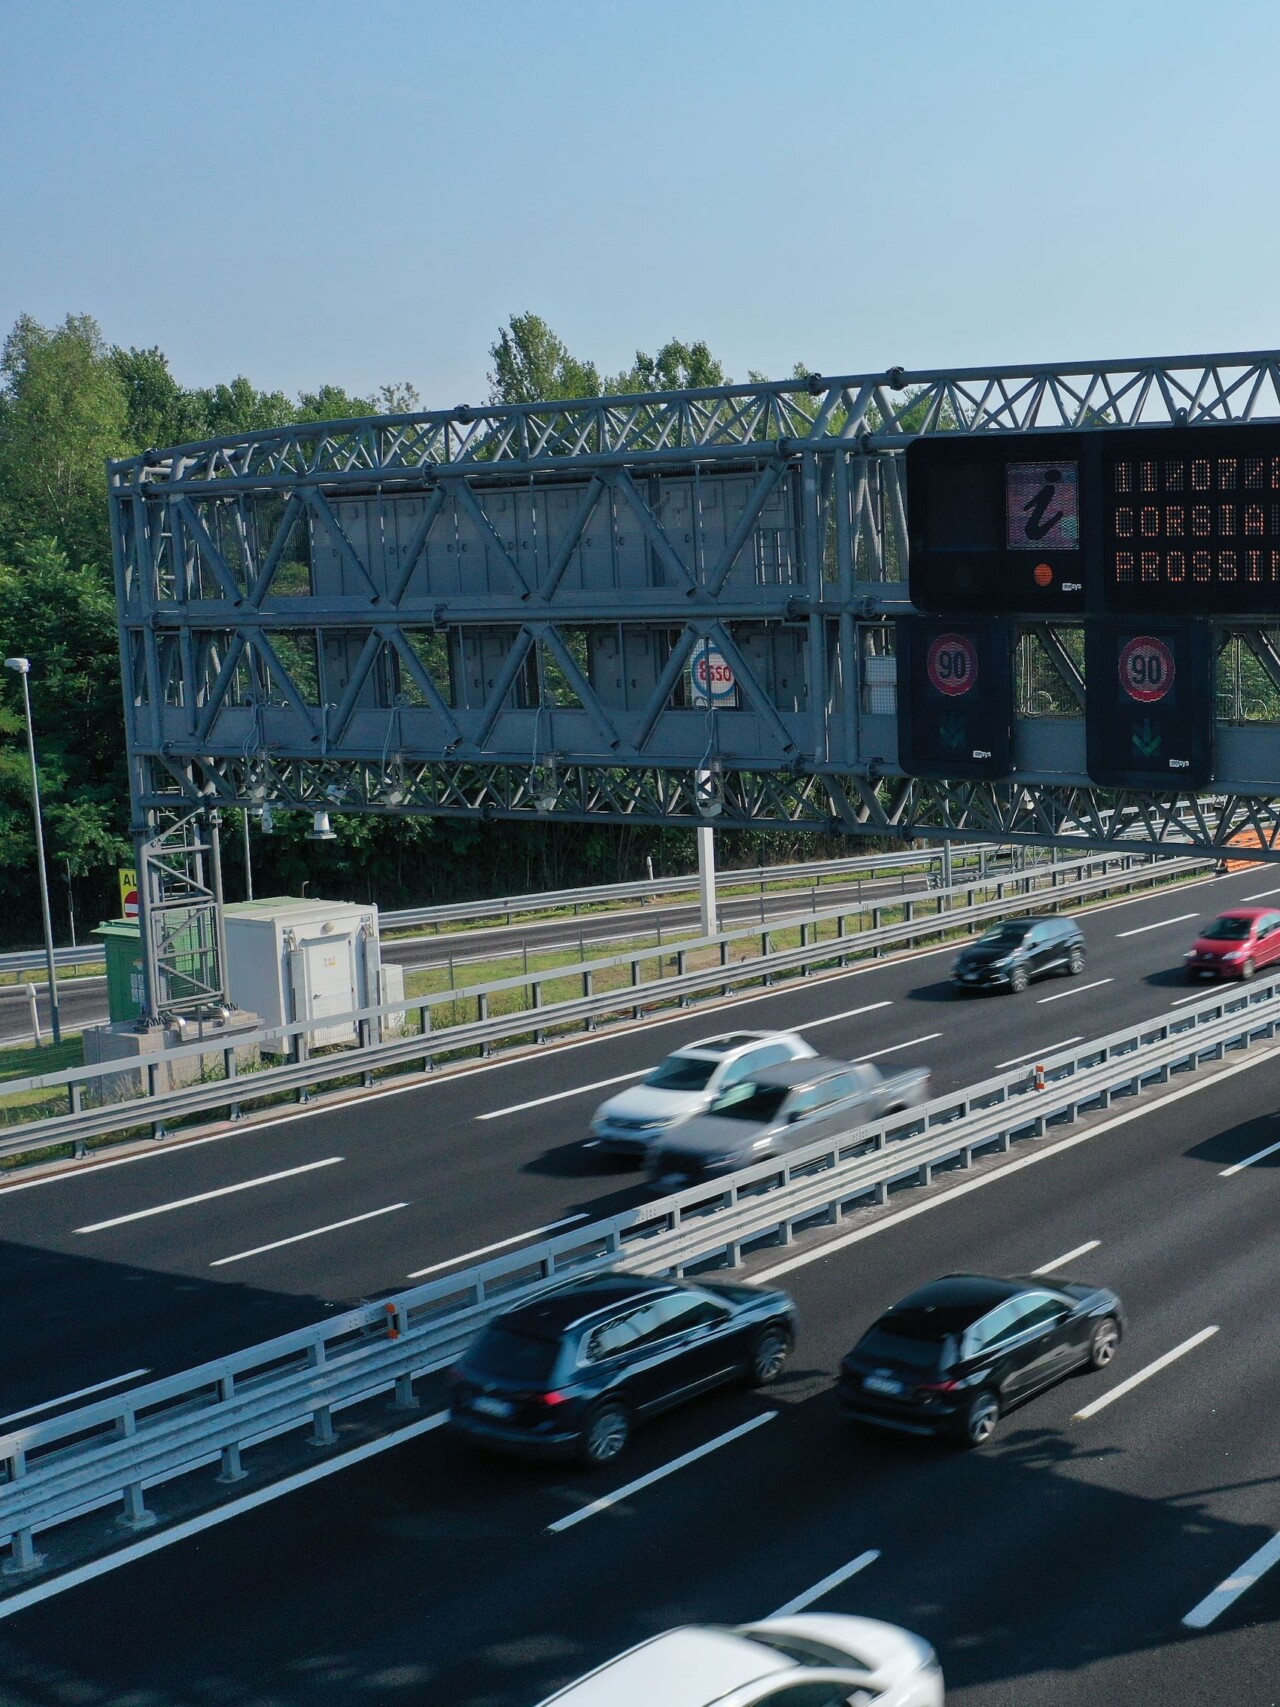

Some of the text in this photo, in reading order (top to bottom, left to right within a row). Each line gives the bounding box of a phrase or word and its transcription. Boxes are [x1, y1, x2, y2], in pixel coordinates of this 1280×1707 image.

[1115, 504, 1264, 537] CORSIA
[937, 650, 967, 680] 90
[1131, 654, 1162, 685] 90
[123, 873, 137, 887] AL
